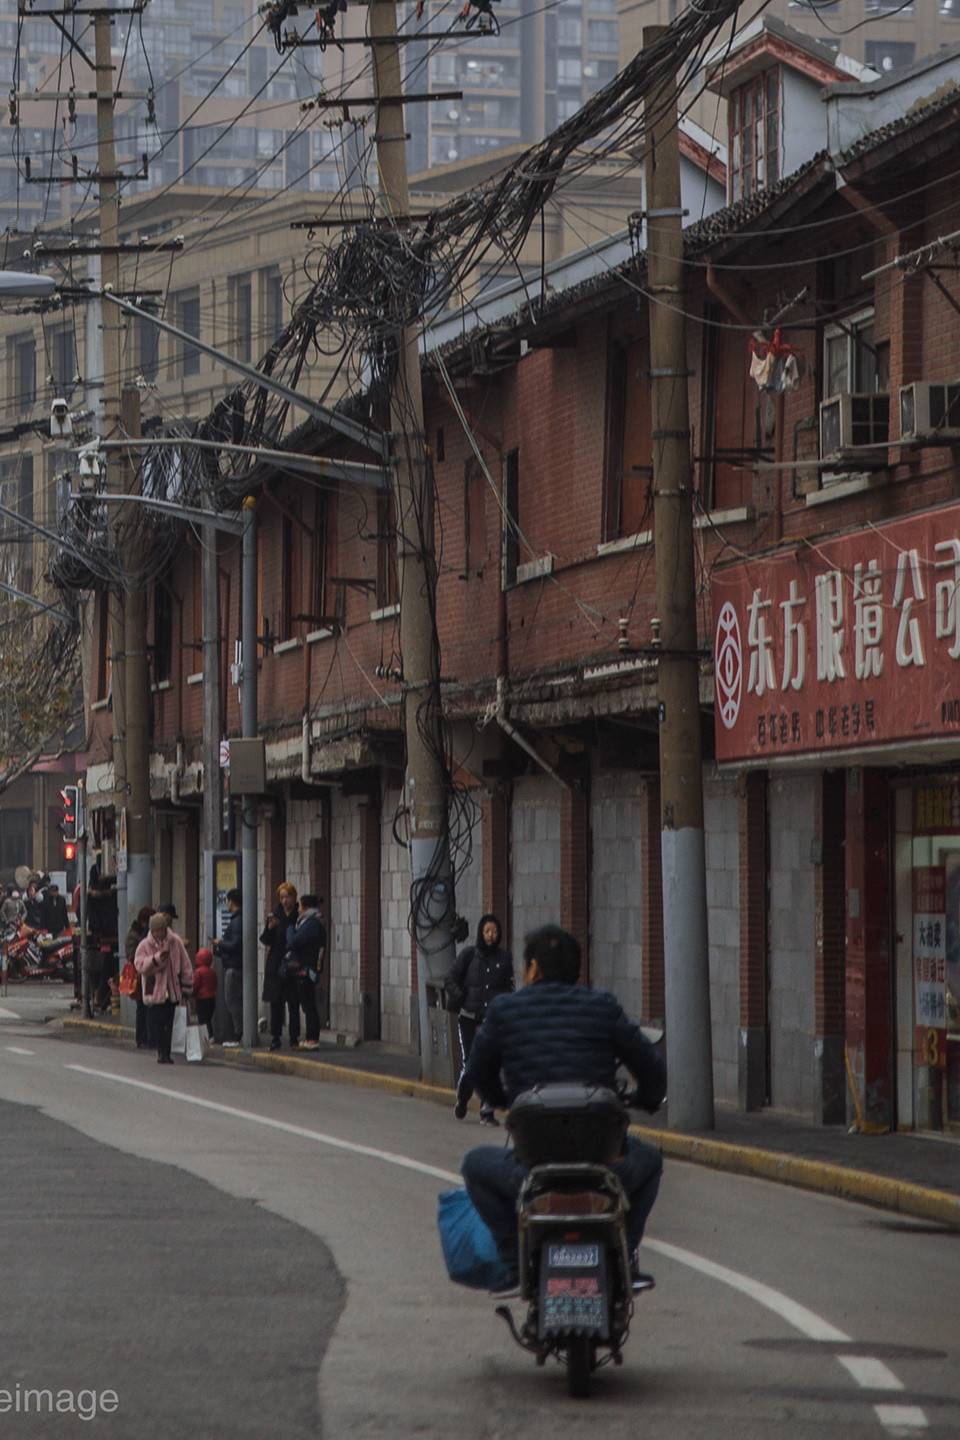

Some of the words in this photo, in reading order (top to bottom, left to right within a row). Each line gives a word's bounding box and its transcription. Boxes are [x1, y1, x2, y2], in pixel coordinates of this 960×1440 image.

[746, 539, 960, 697] 东方眼镜公司
